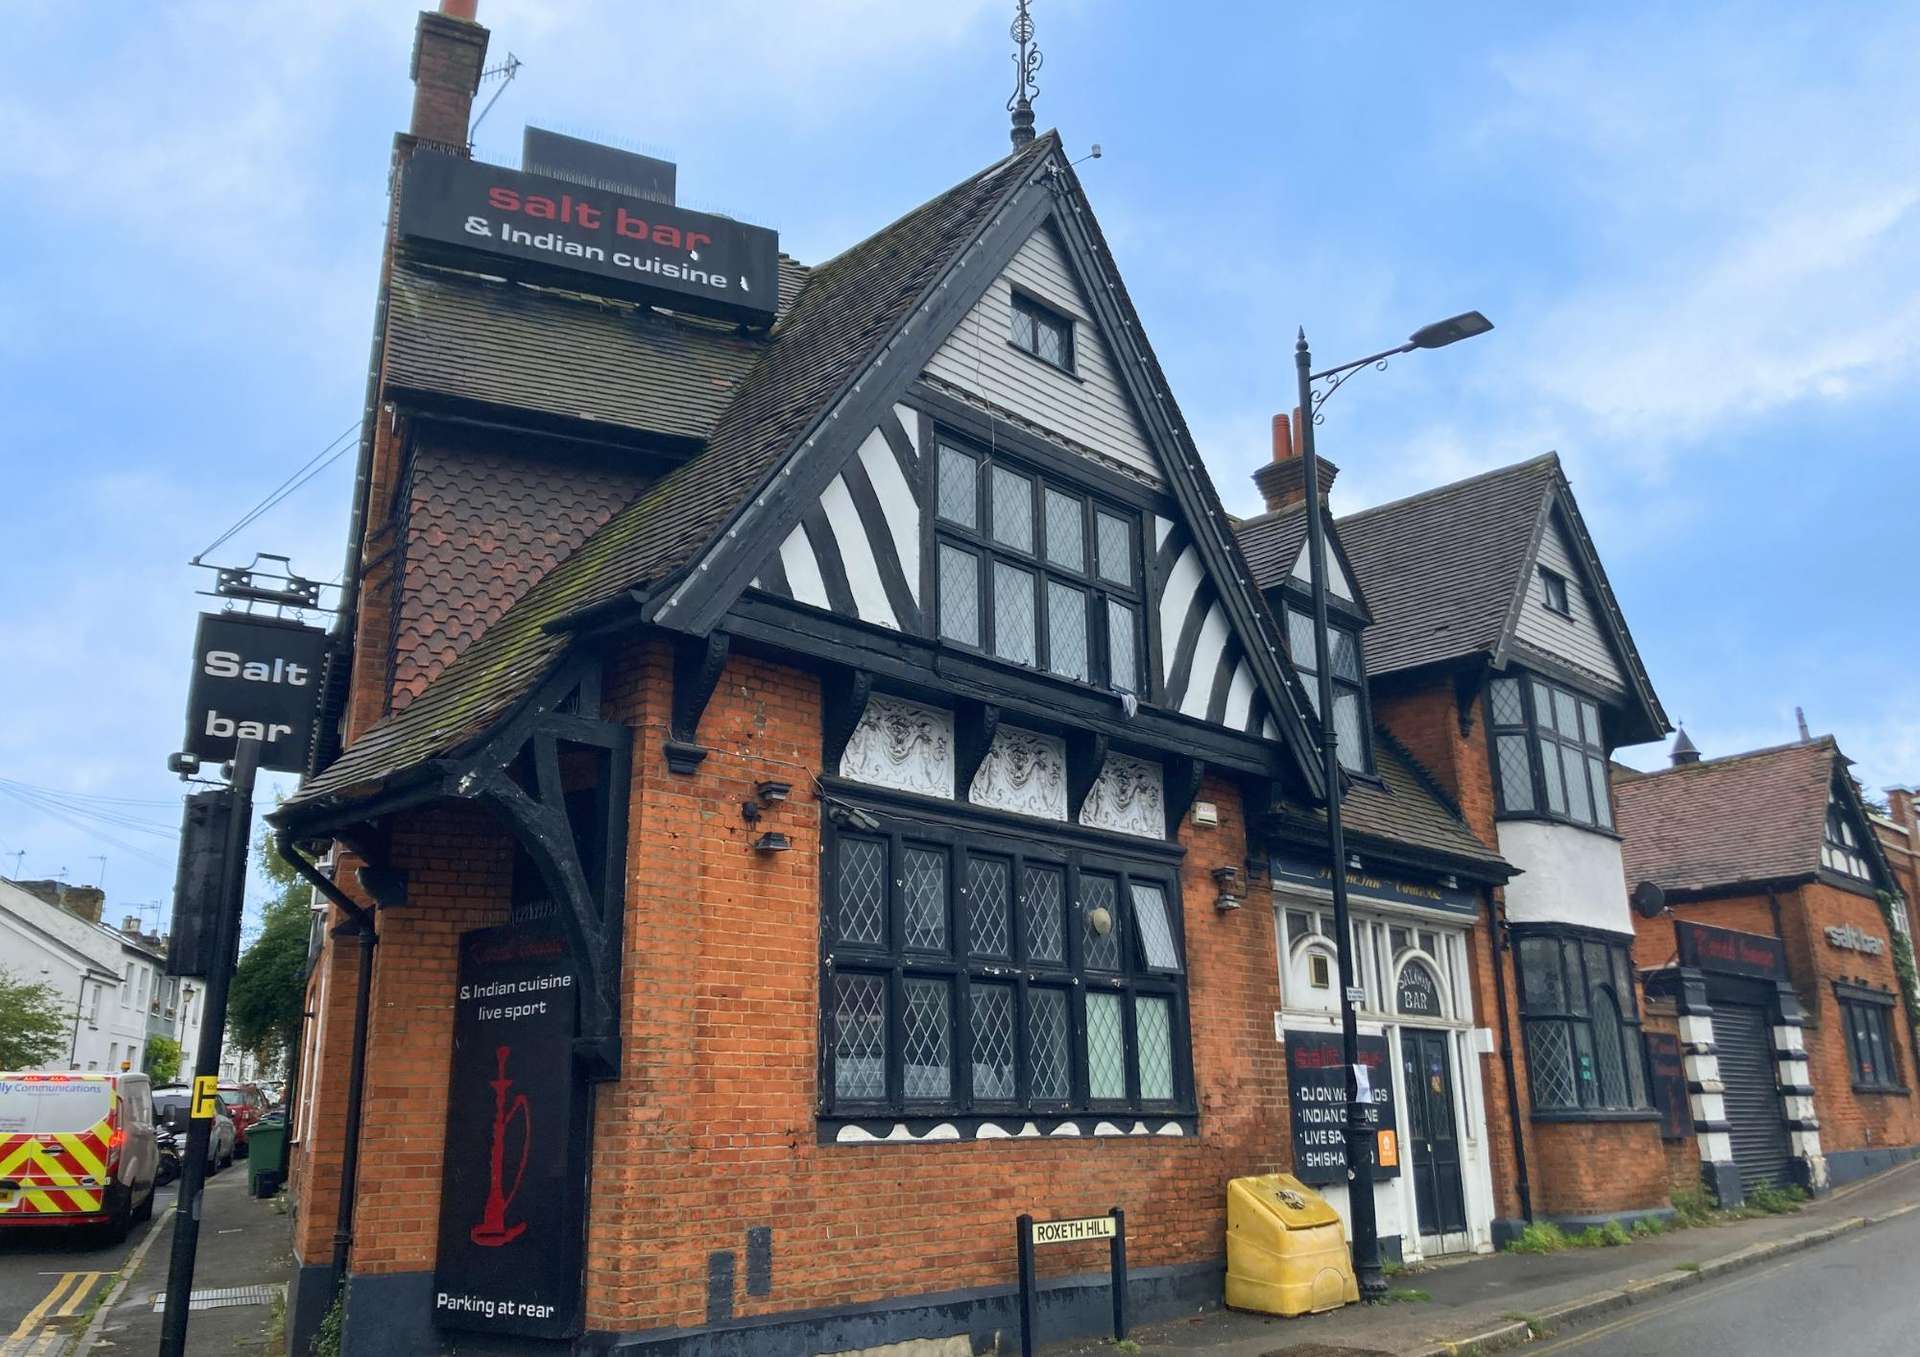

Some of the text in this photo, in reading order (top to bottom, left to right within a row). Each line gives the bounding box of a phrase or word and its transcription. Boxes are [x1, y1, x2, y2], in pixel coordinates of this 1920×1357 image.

[487, 186, 713, 251] salt bar
[464, 215, 728, 289] & Indian cuisine
[204, 650, 308, 686] Salt
[205, 710, 292, 742] bar
[460, 975, 571, 999] & Indian cuisine
[1400, 968, 1431, 994] SALOON
[478, 1001, 547, 1020] live sport
[1404, 991, 1428, 1010] BAR
[14, 1083, 102, 1094] Communications
[1301, 1086, 1315, 1102] DJ
[1316, 1086, 1332, 1102] ON
[1303, 1108, 1339, 1122] INDIAN
[1304, 1130, 1328, 1145] LIVE
[1306, 1151, 1346, 1167] SHISHA
[1037, 1219, 1110, 1241] ROXETH HILL
[437, 1293, 555, 1318] Parking at rear
